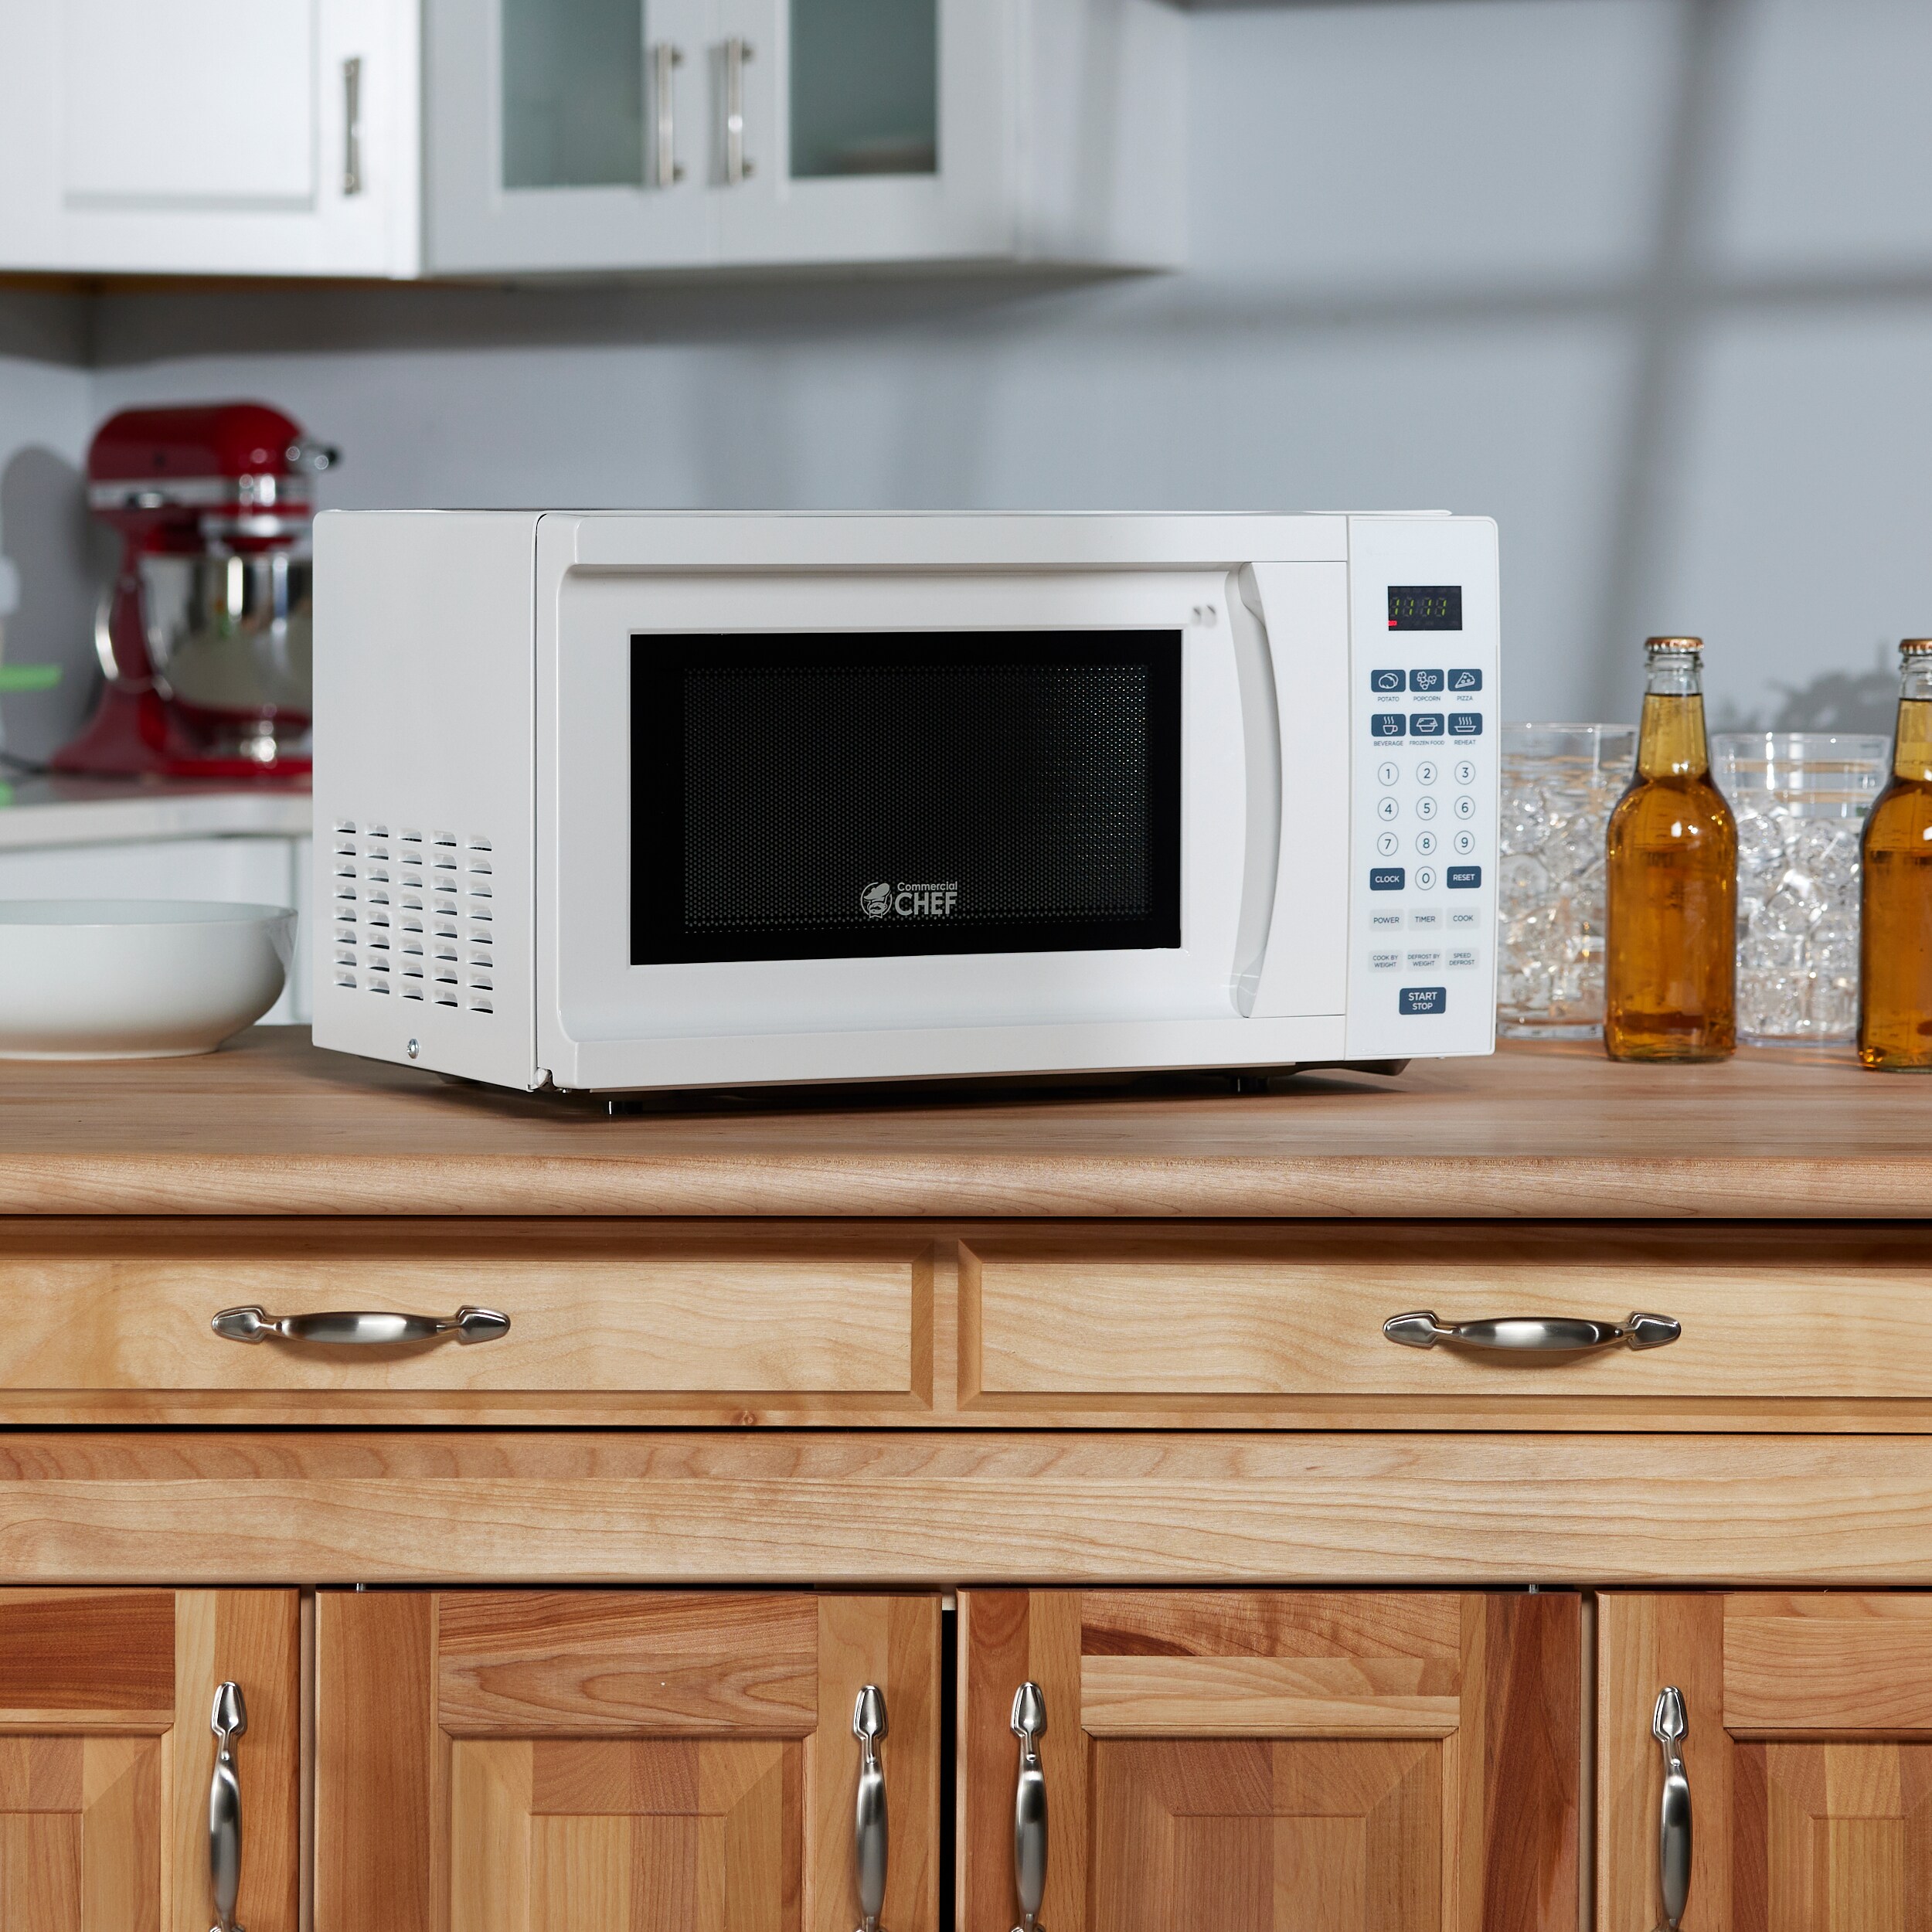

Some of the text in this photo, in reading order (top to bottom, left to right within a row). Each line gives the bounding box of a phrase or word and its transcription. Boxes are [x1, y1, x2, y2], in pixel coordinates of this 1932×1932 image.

[1423, 768, 1430, 779] 2
[1461, 767, 1469, 778] 3
[1385, 804, 1393, 815] 4
[1423, 803, 1430, 814] 5
[1461, 802, 1468, 813] 6
[1385, 838, 1391, 849] 7
[1423, 838, 1430, 849] 8
[1461, 837, 1468, 848] 9
[1422, 873, 1430, 883] 0
[897, 881, 957, 891] Commercial
[895, 892, 957, 916] CHEF
[1408, 992, 1438, 1001] START
